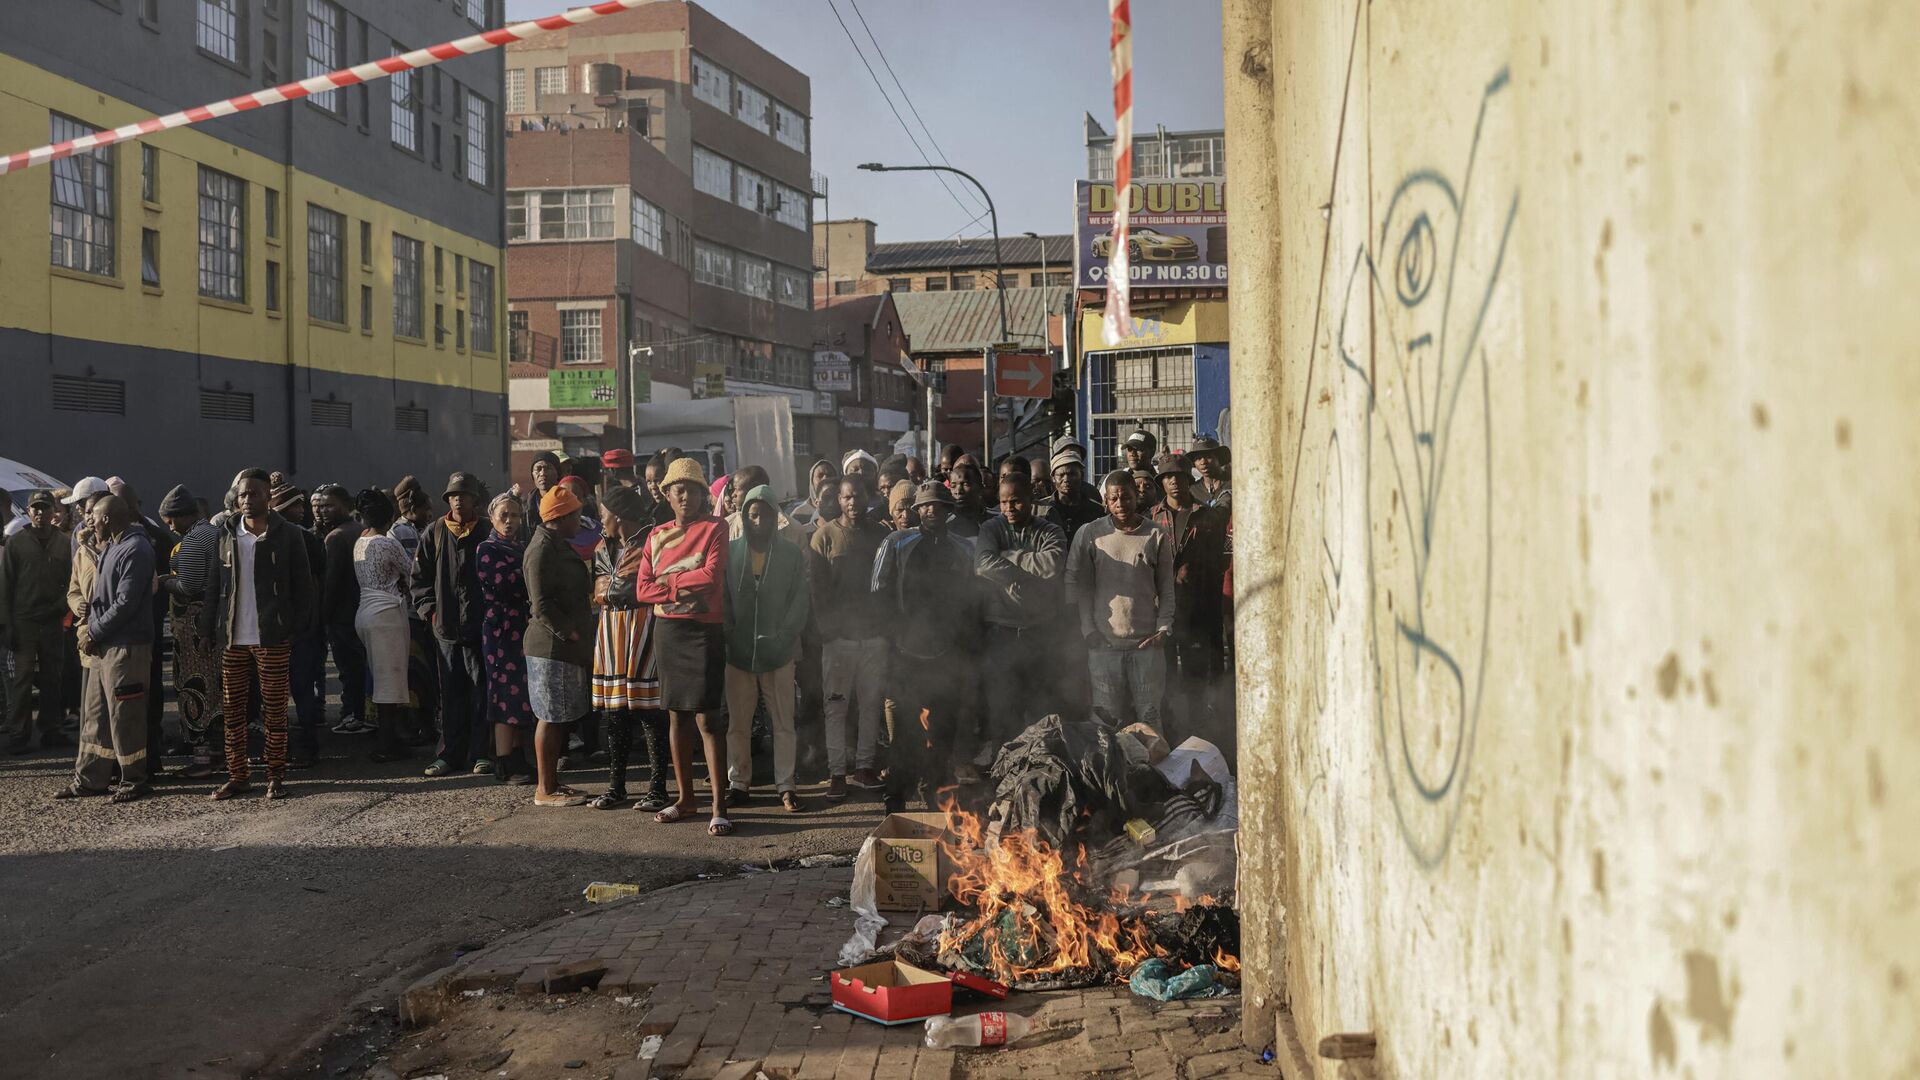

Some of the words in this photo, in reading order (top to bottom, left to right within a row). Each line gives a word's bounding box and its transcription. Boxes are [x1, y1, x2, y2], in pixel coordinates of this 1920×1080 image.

[1090, 183, 1227, 214] DOUBL
[1089, 217, 1100, 225] WE
[1140, 216, 1147, 224] IN
[1148, 216, 1174, 224] SELLING
[1176, 216, 1184, 224] OF
[1185, 215, 1202, 224] NEW
[1203, 215, 1216, 224] AND
[1103, 266, 1153, 280] SOP
[1157, 265, 1210, 280] NO.30
[815, 371, 828, 382] TO
[832, 371, 849, 381] LET
